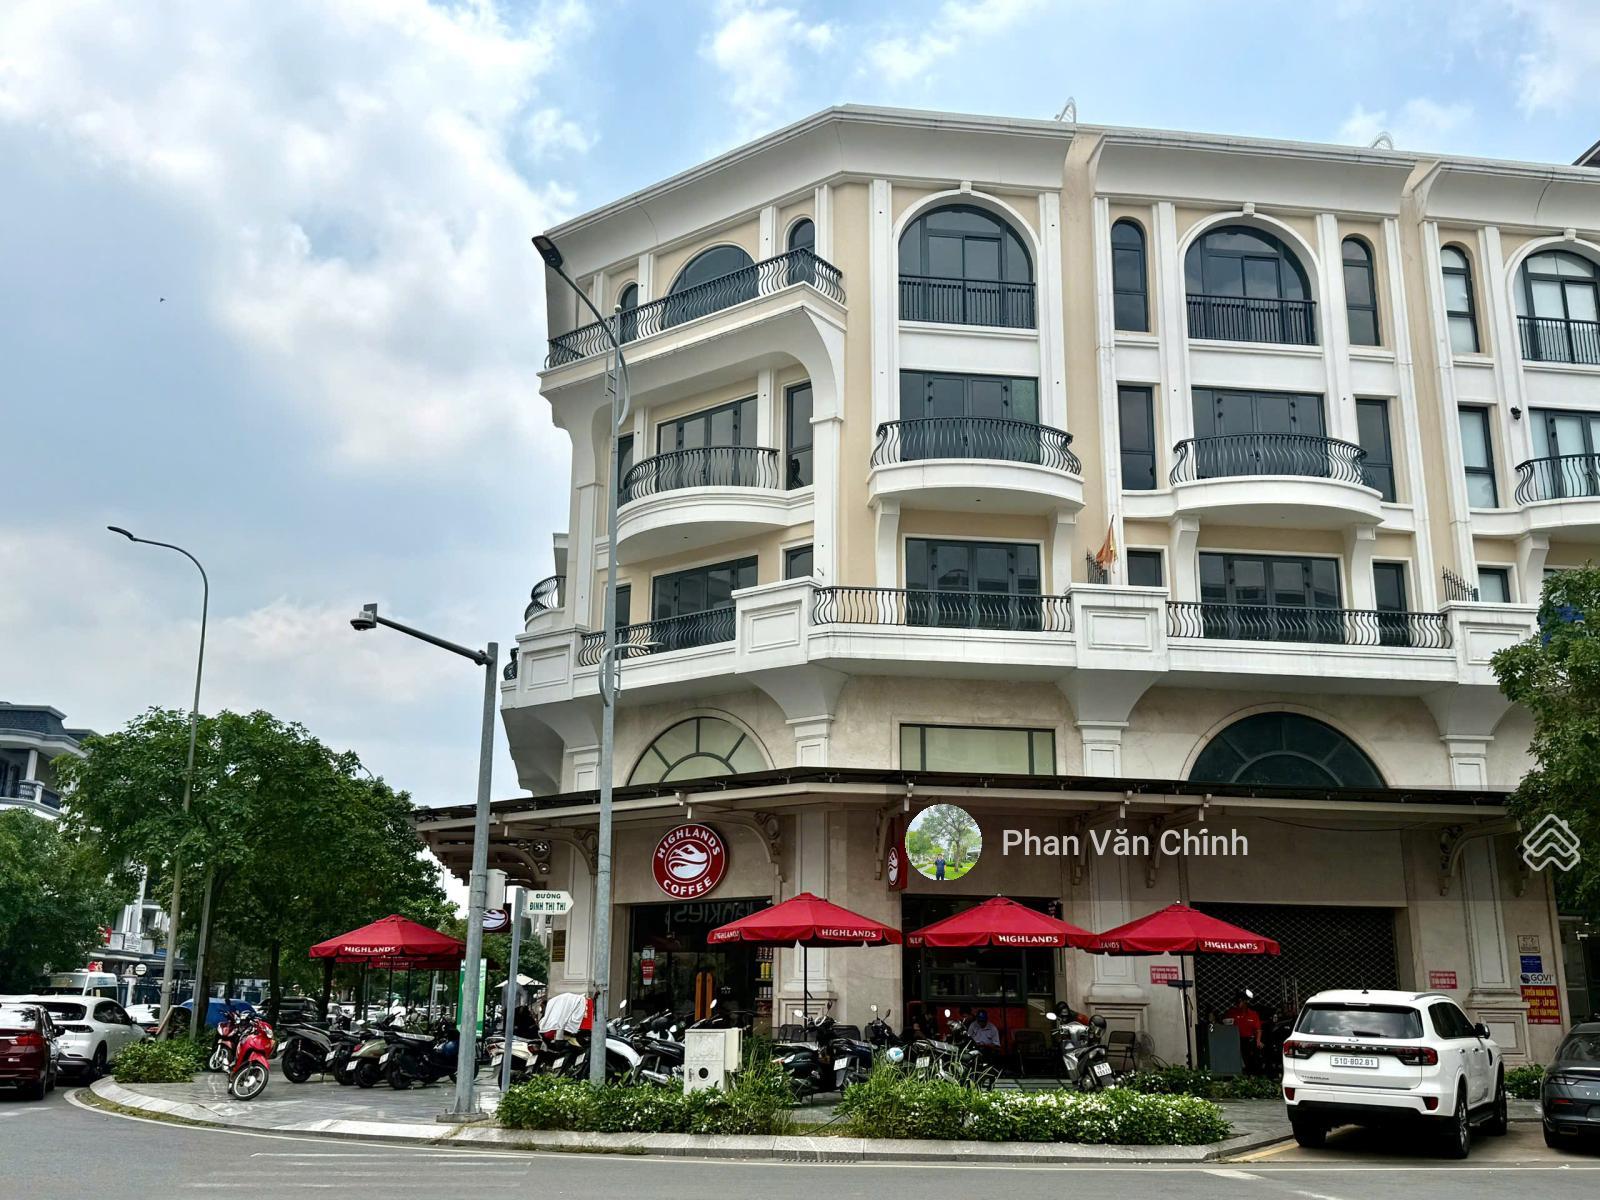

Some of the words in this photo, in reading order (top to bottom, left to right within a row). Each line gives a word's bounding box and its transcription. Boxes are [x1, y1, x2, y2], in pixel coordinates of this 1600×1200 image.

[657, 828, 720, 859] HIGHLANDS
[663, 876, 712, 896] COFFEE
[821, 928, 877, 938] HIGHLANDS
[998, 935, 1059, 944] HIGHLANDS
[344, 946, 396, 954] HIGHLANDS
[1204, 941, 1258, 951] HIGHLANDS
[1530, 973, 1552, 982] GOVI
